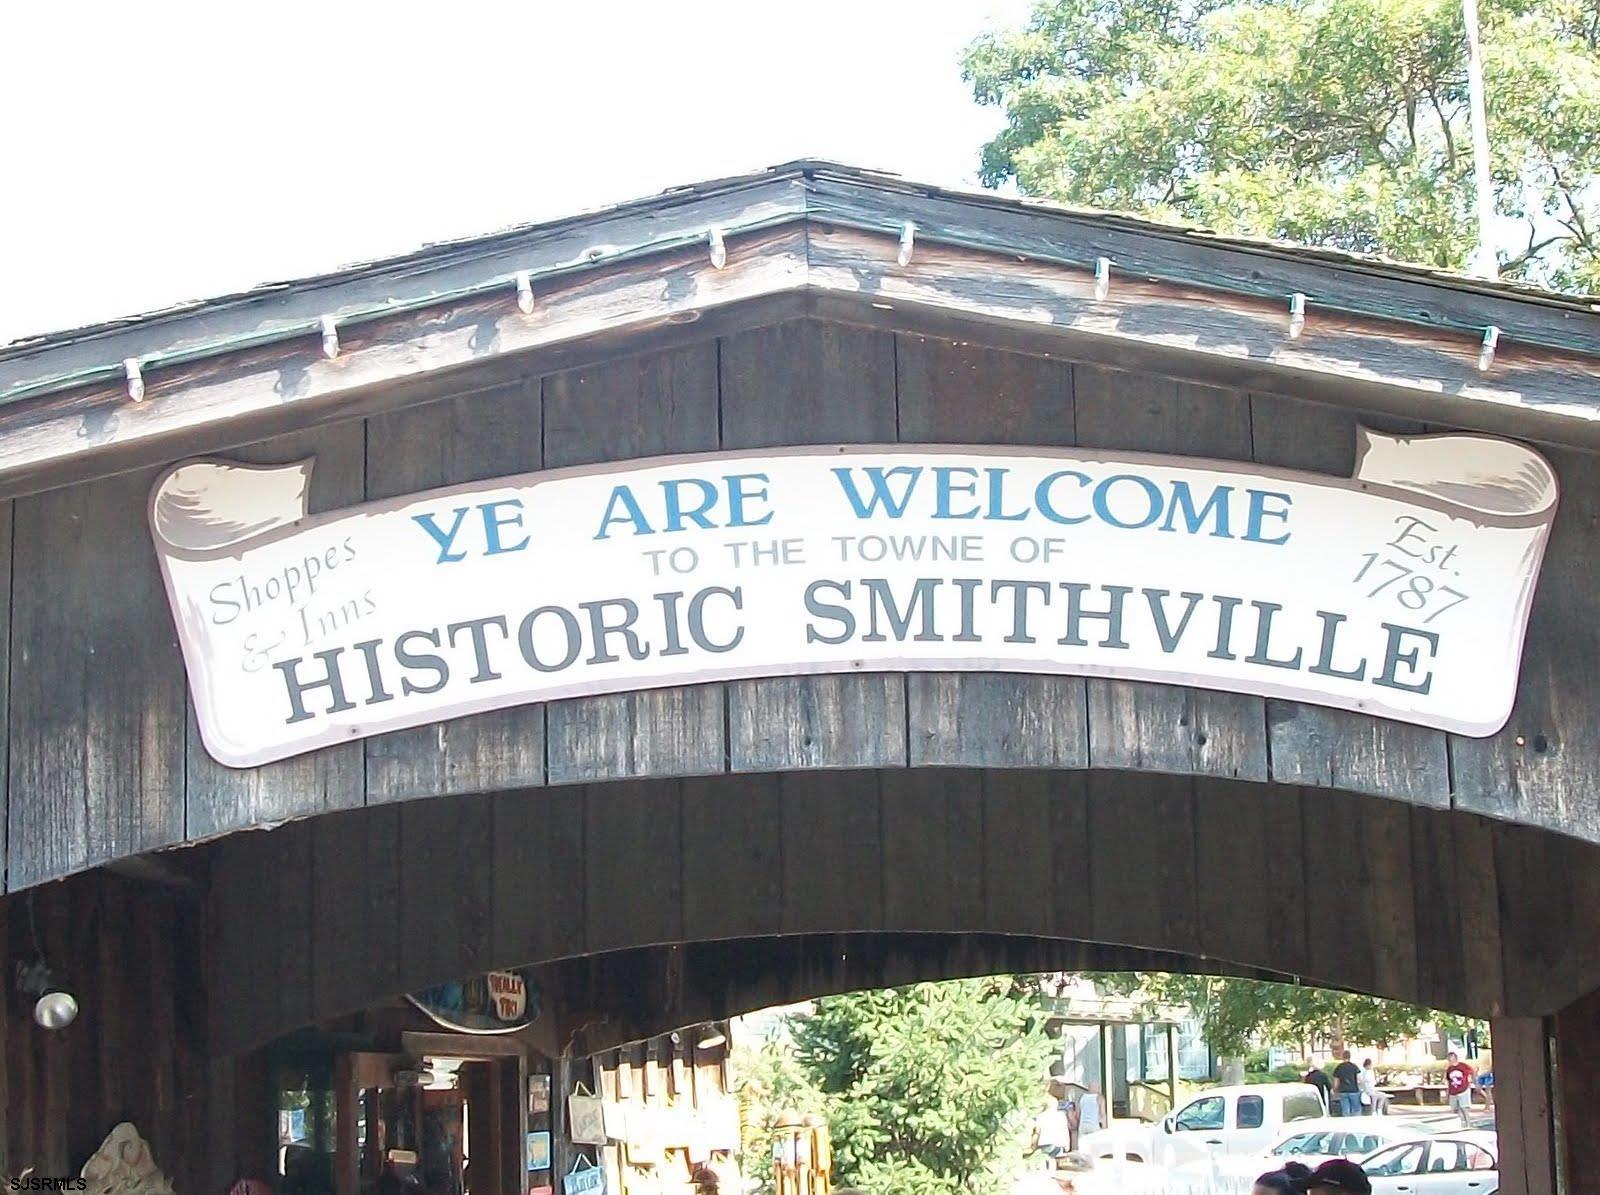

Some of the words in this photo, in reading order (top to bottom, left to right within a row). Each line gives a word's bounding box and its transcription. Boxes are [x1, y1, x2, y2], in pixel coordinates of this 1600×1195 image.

[411, 499, 530, 564] YE
[592, 474, 775, 541] ARE
[830, 466, 1293, 546] WELCOME
[643, 546, 699, 576] TO
[724, 538, 806, 569] THE
[831, 535, 985, 562] TOWNE
[1010, 536, 1066, 564] OF
[1385, 515, 1461, 577] Est.
[209, 537, 356, 625] Shoppes
[1352, 552, 1470, 624] 1787
[241, 630, 286, 672] &
[299, 590, 376, 645] Inns
[272, 586, 745, 724] HISTORIC
[803, 578, 1440, 696] SMITHVILLE
